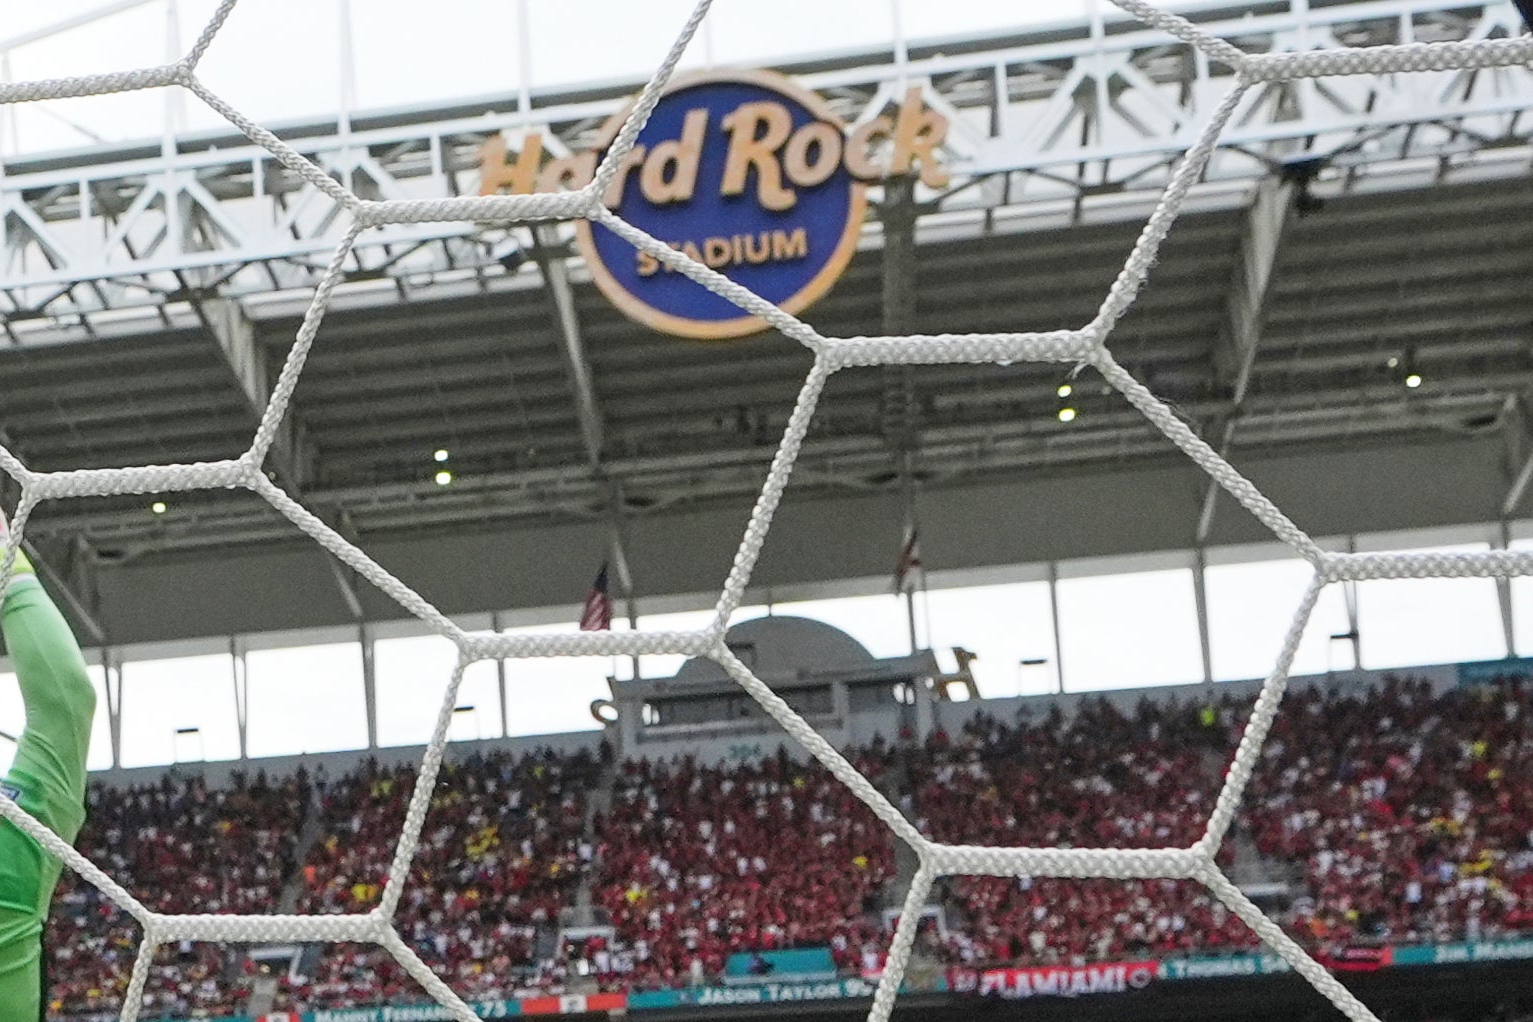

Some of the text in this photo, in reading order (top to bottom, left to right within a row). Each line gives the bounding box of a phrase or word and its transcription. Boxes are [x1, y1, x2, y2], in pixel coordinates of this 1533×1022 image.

[477, 87, 951, 210] Hard Rock
[697, 986, 761, 1005] JASON
[766, 983, 841, 1001] TAYLOR
